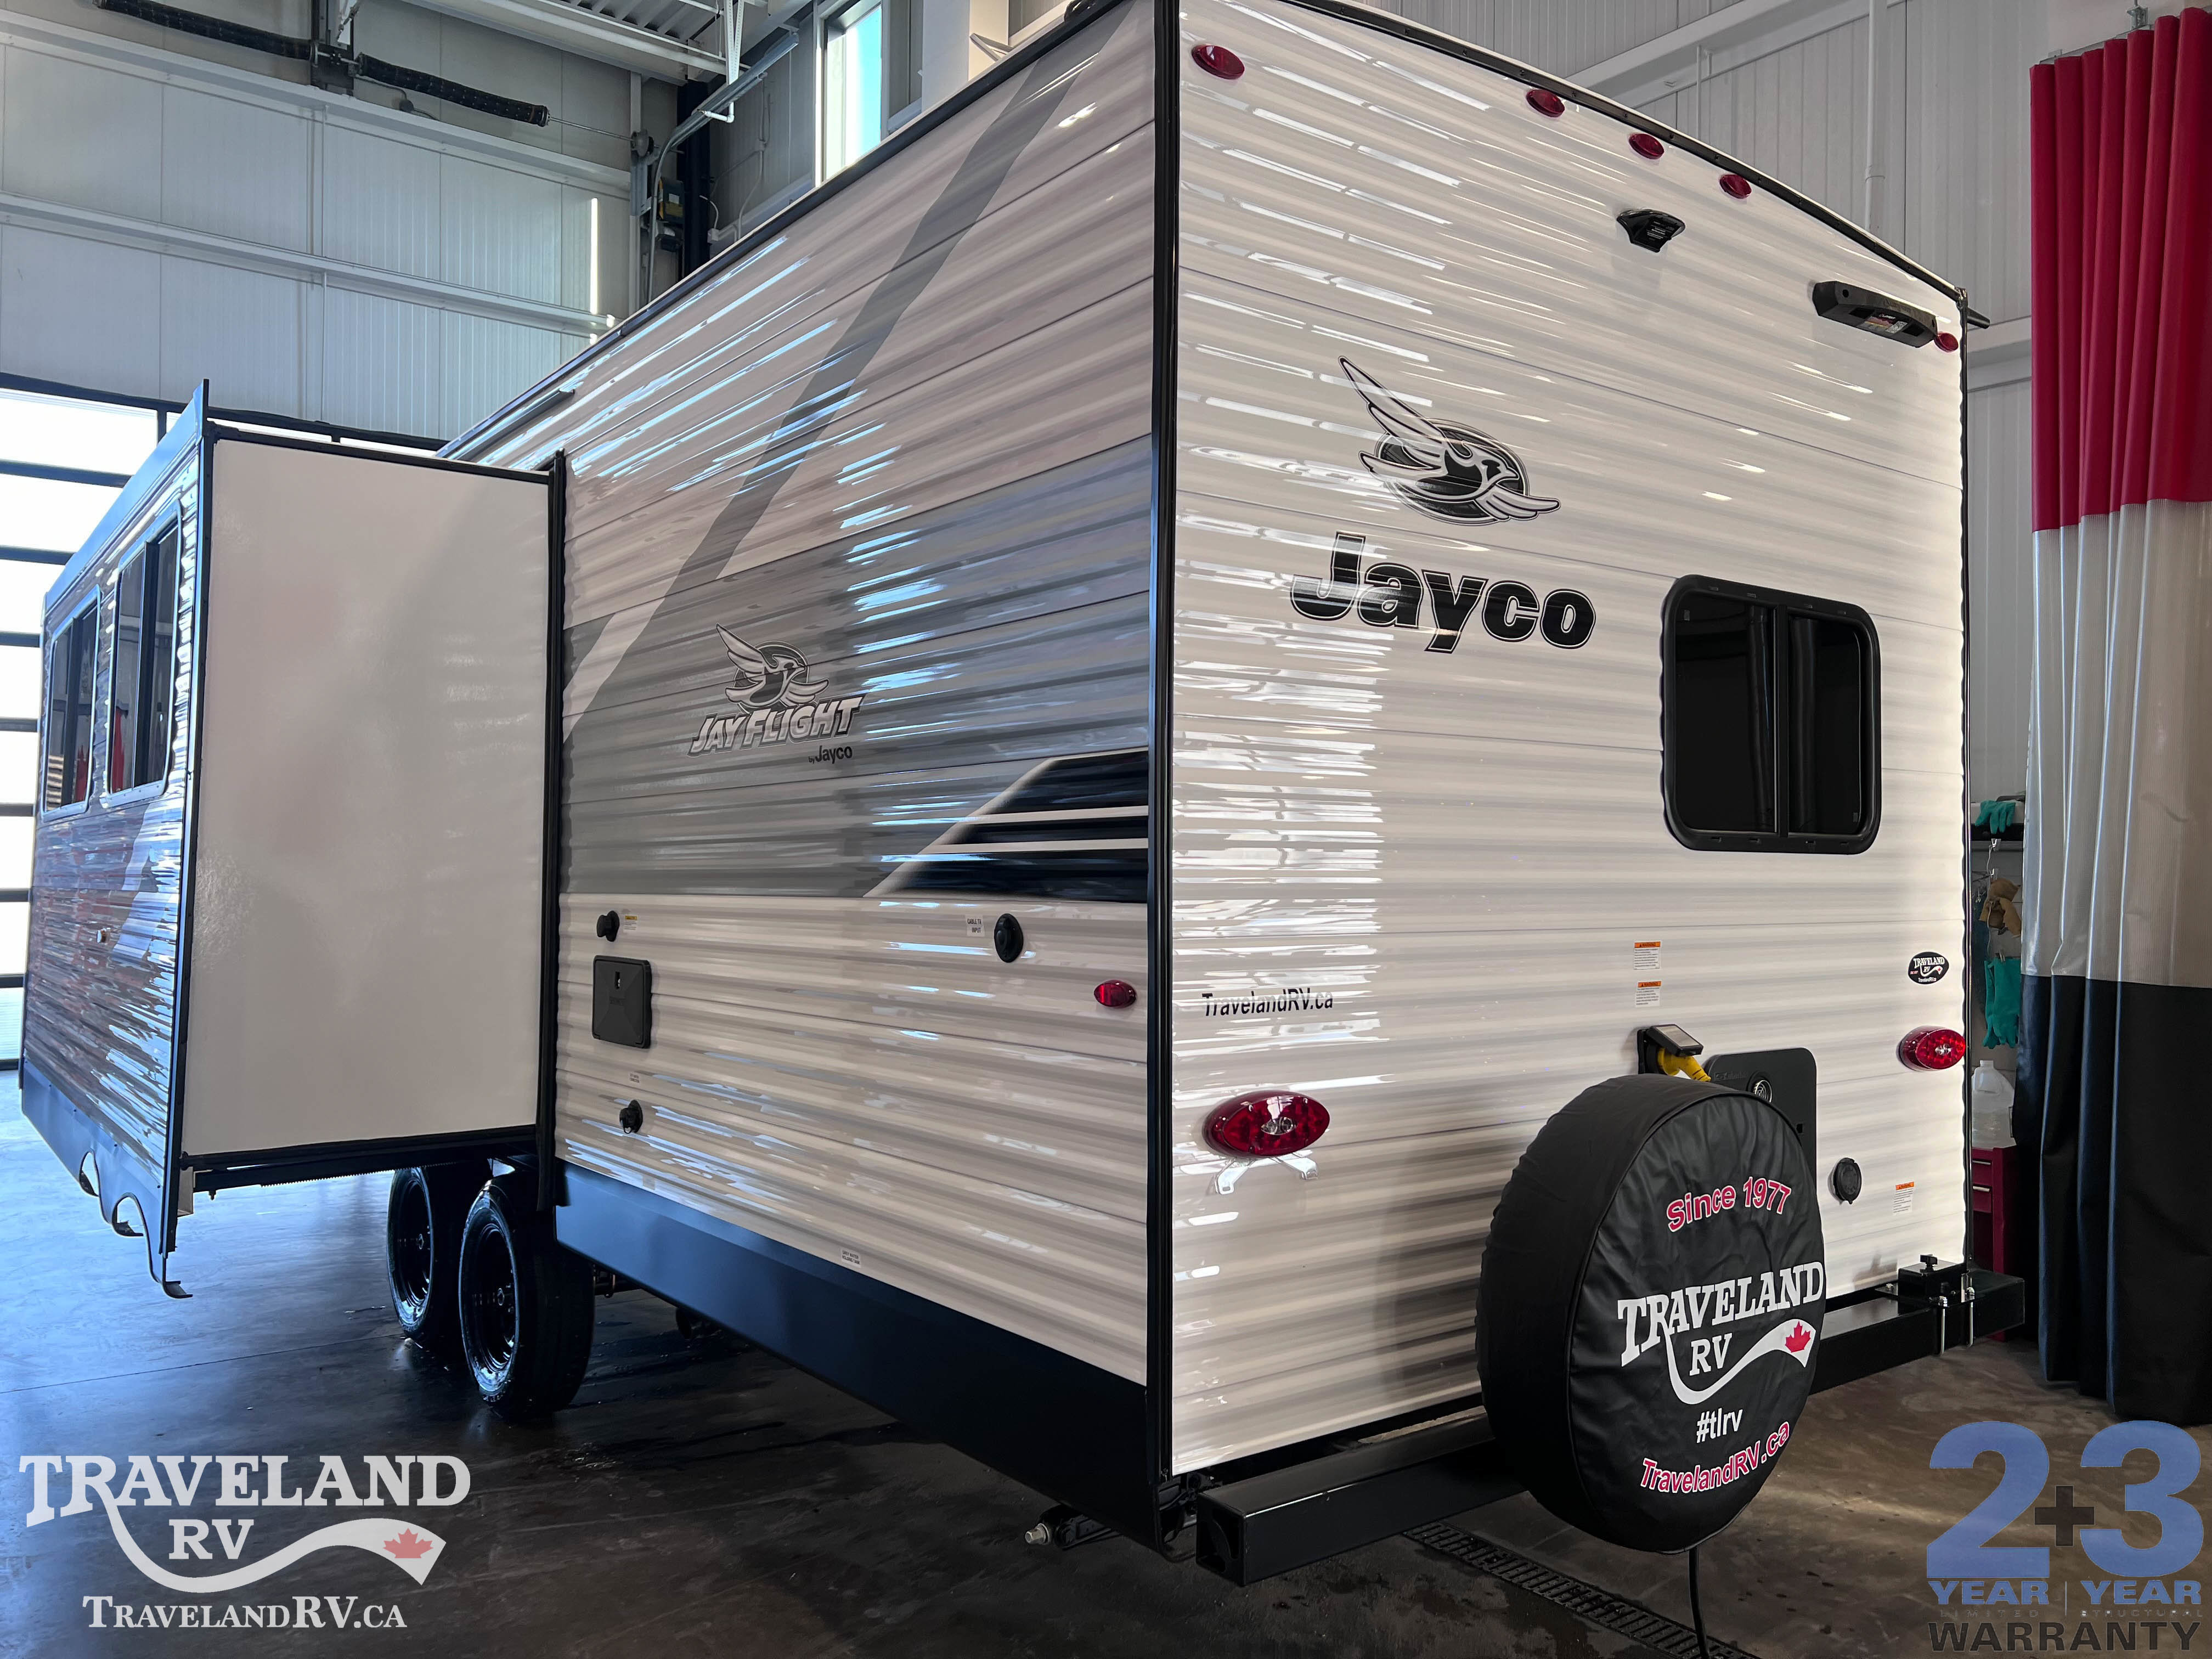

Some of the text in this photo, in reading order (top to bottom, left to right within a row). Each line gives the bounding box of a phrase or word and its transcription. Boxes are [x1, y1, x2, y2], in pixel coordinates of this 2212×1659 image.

[1290, 531, 1596, 654] Jayco
[815, 745, 853, 764] Jayco
[1913, 957, 1945, 969] TRAVELAND
[1201, 987, 1334, 1017] TravelandRV.ca
[1667, 1177, 1792, 1232] Since 1977
[1617, 1262, 1824, 1367] TRAVELAND
[1690, 1333, 1733, 1376] RV
[1696, 1408, 1743, 1443] #tlrv
[1640, 1421, 1790, 1493] TravelandRV.ca
